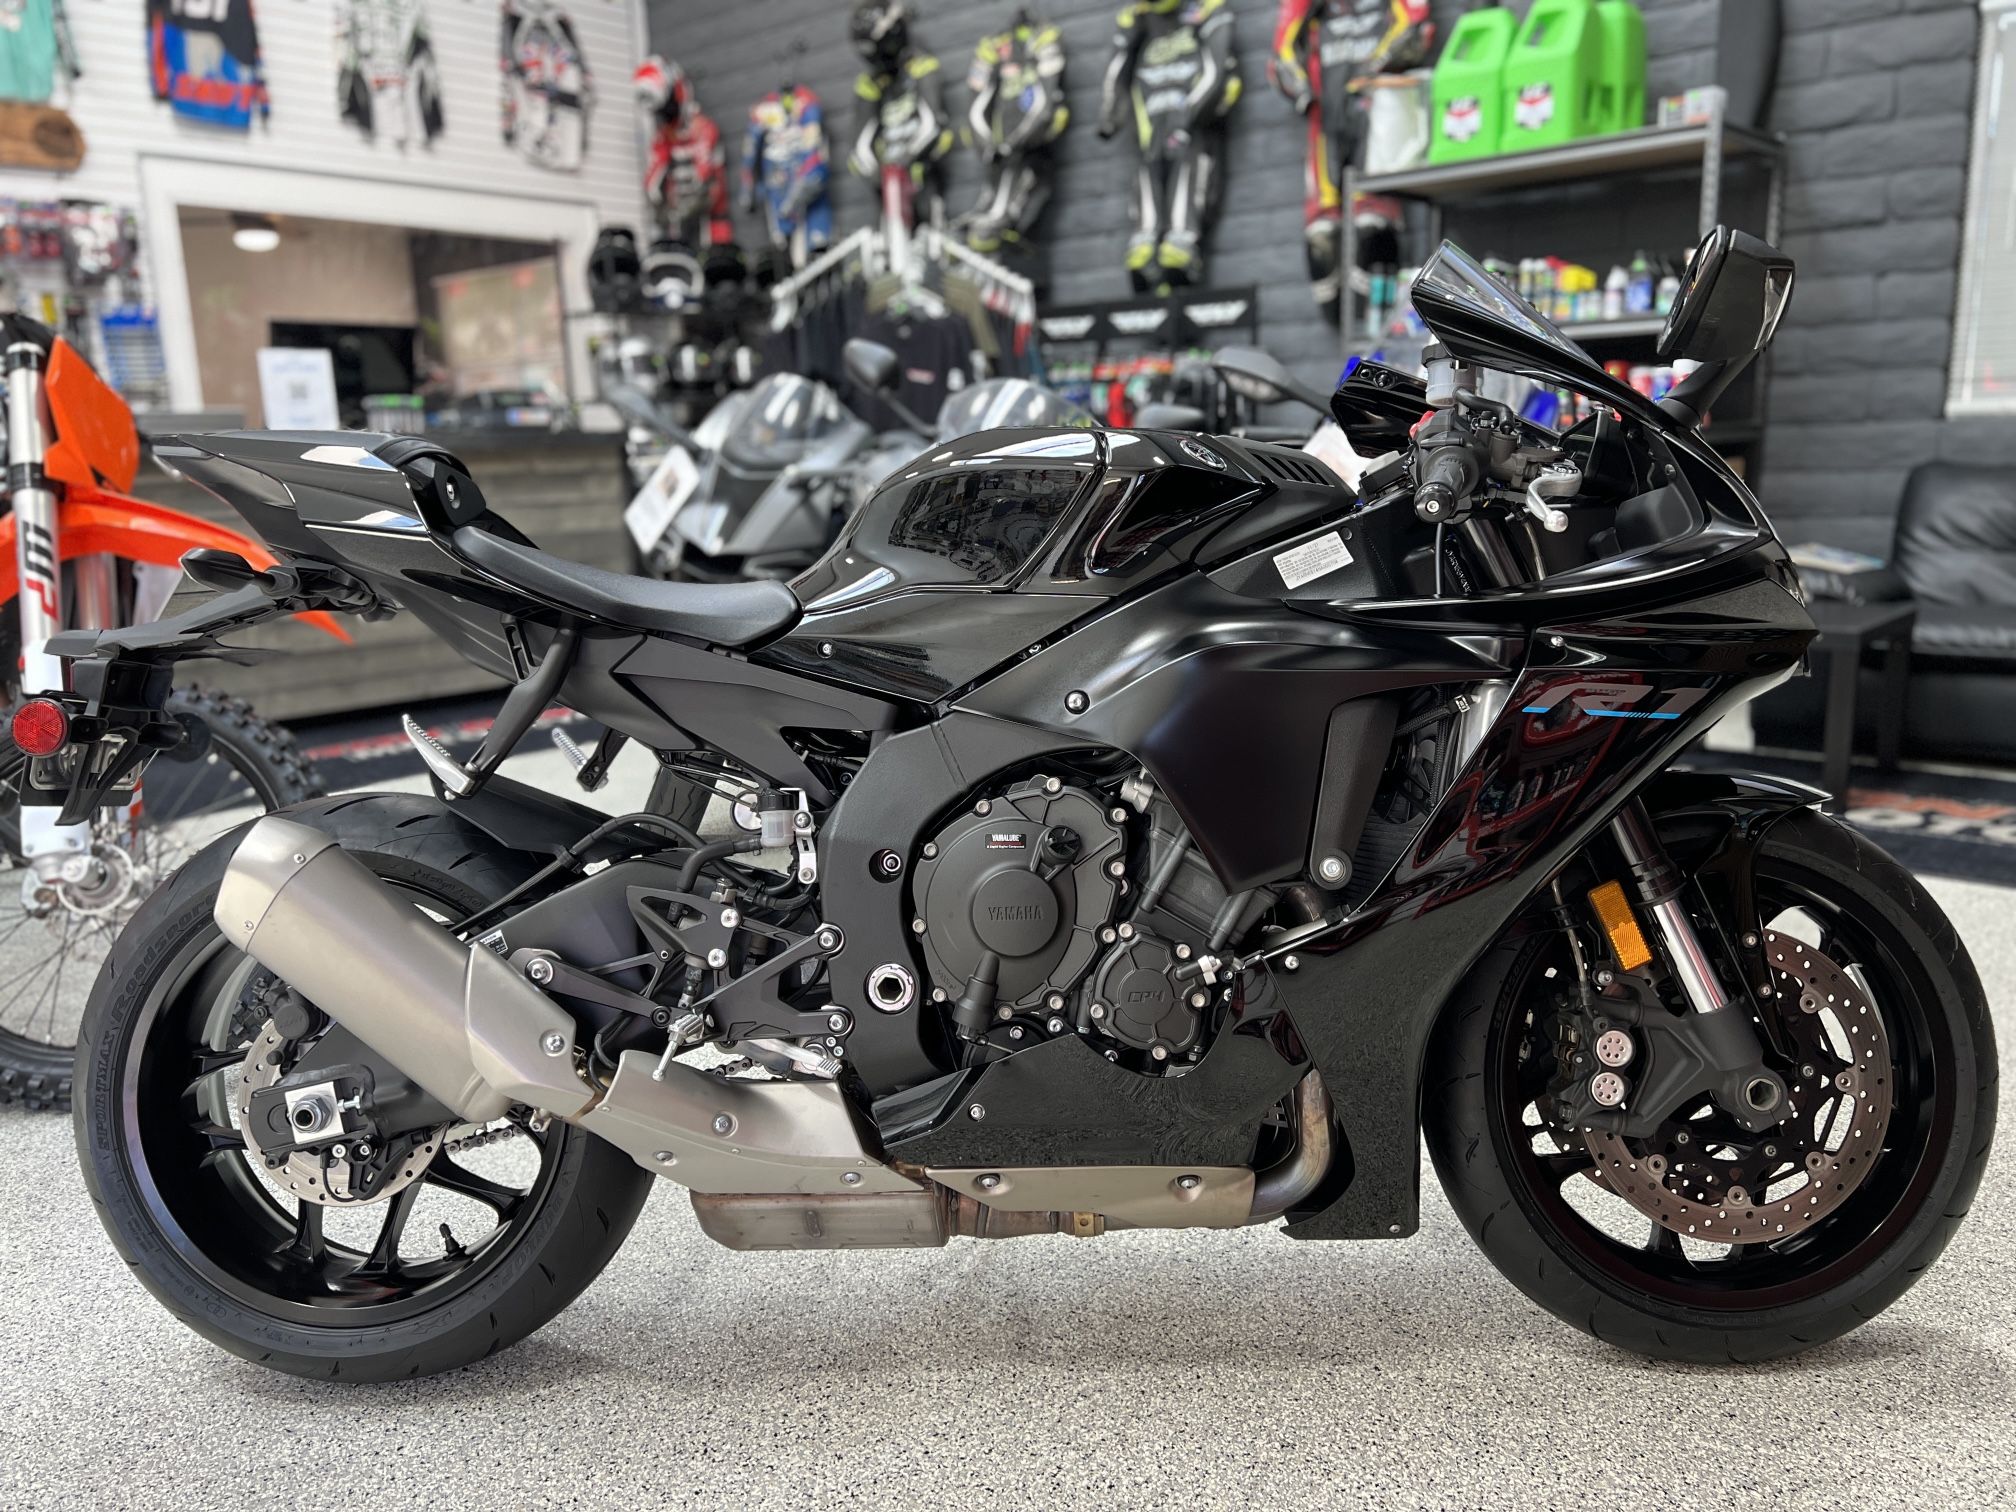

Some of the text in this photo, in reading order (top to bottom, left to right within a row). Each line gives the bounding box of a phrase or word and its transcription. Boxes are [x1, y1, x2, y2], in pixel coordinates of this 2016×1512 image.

[1521, 682, 1711, 720] R1
[991, 834, 1021, 842] YAMALUBE
[987, 906, 1043, 921] YAMAHA
